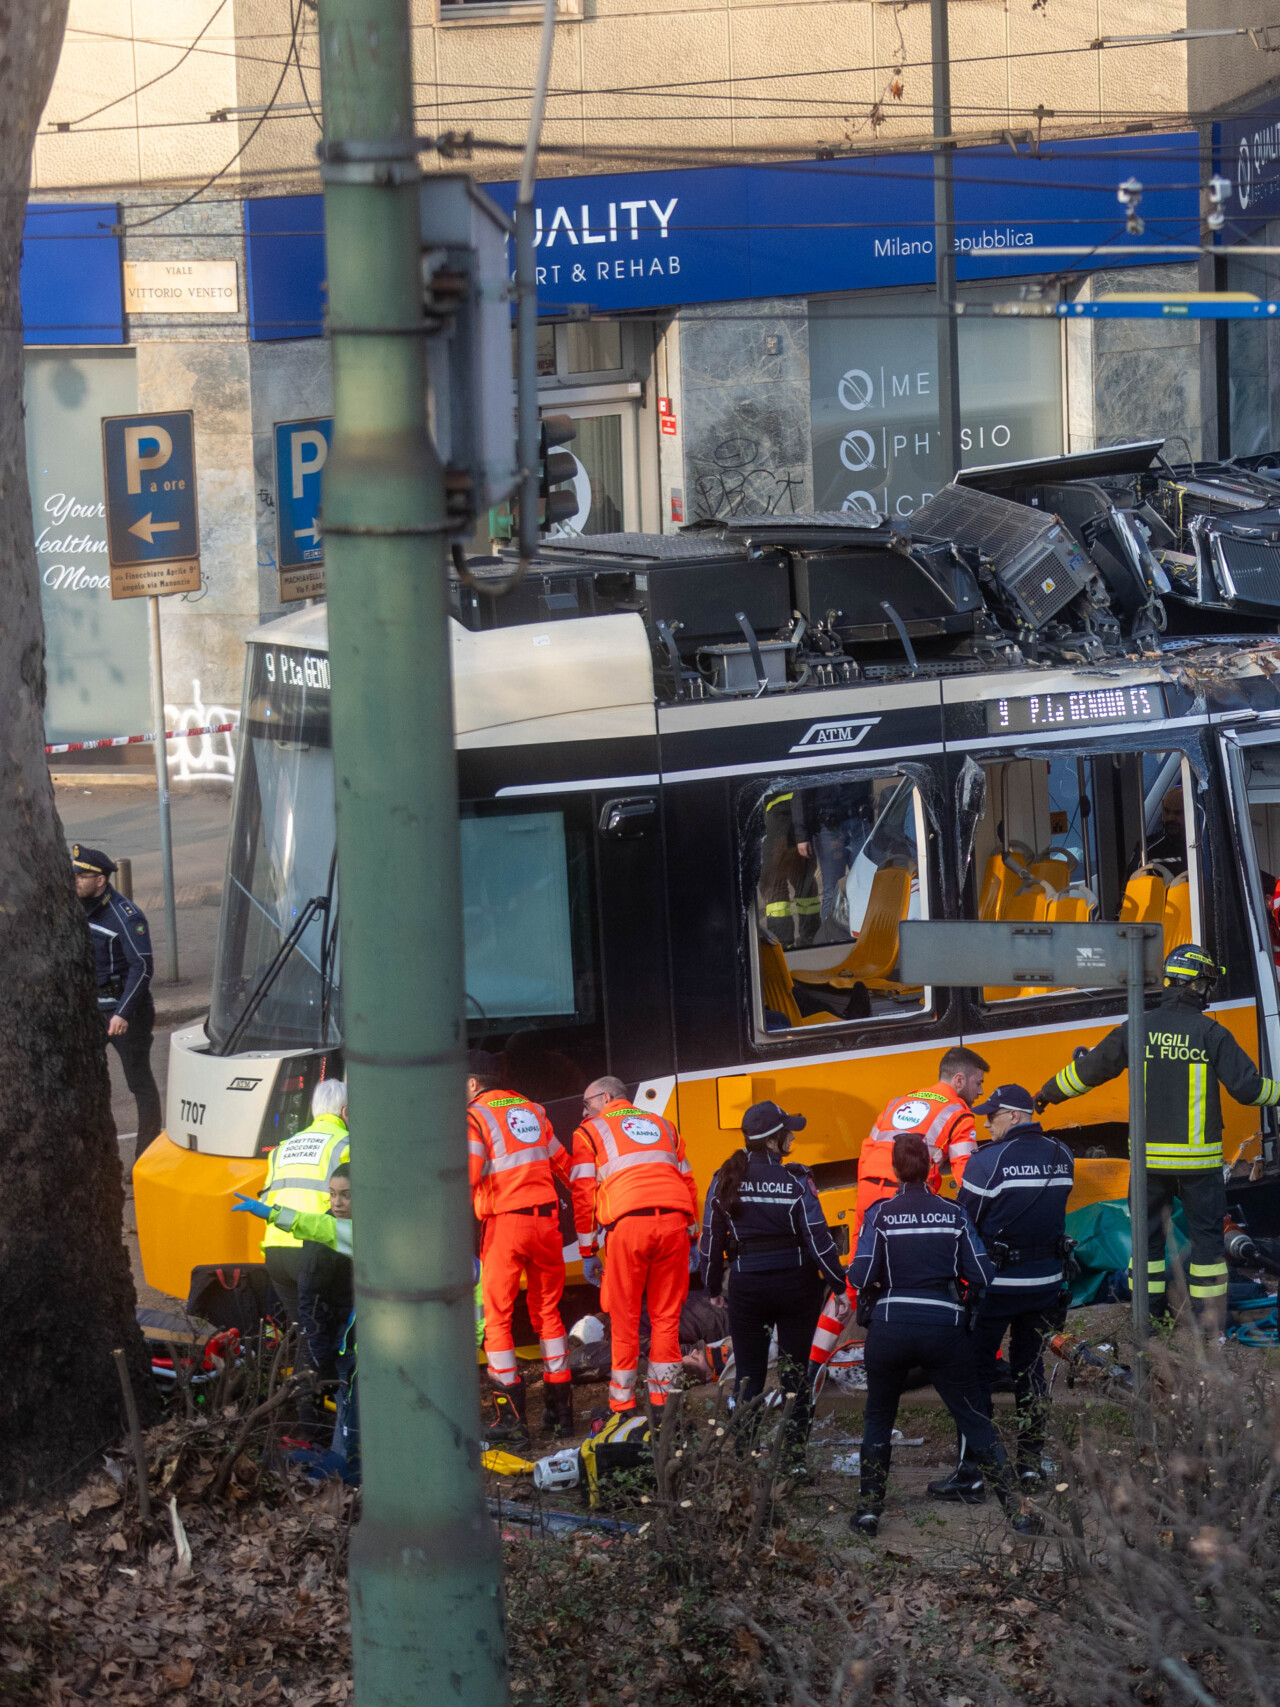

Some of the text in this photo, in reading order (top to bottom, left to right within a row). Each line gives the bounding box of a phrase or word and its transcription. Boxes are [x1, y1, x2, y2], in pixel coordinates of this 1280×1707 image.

[874, 228, 1034, 258] Milano epubblica
[166, 266, 193, 275] VIALE
[571, 263, 586, 282] &
[598, 256, 681, 280] REHAB
[128, 287, 233, 298] VITTORIO VENETO
[894, 425, 1011, 457] PHSIO
[124, 425, 173, 495] P
[290, 430, 328, 499] P
[150, 480, 186, 492] a ore
[44, 493, 106, 526] Your
[166, 567, 187, 577] Aprile
[122, 583, 145, 592] angolo
[147, 581, 158, 589] via
[265, 652, 276, 682] 9
[816, 727, 853, 744] ATM
[1149, 1031, 1190, 1047] VIGILI
[180, 1099, 206, 1126] 7707
[521, 1125, 540, 1134] ANPAS
[288, 1137, 325, 1145] DIRETTORE
[1003, 1165, 1039, 1177] POLIZIA
[756, 1181, 793, 1195] LOCALE
